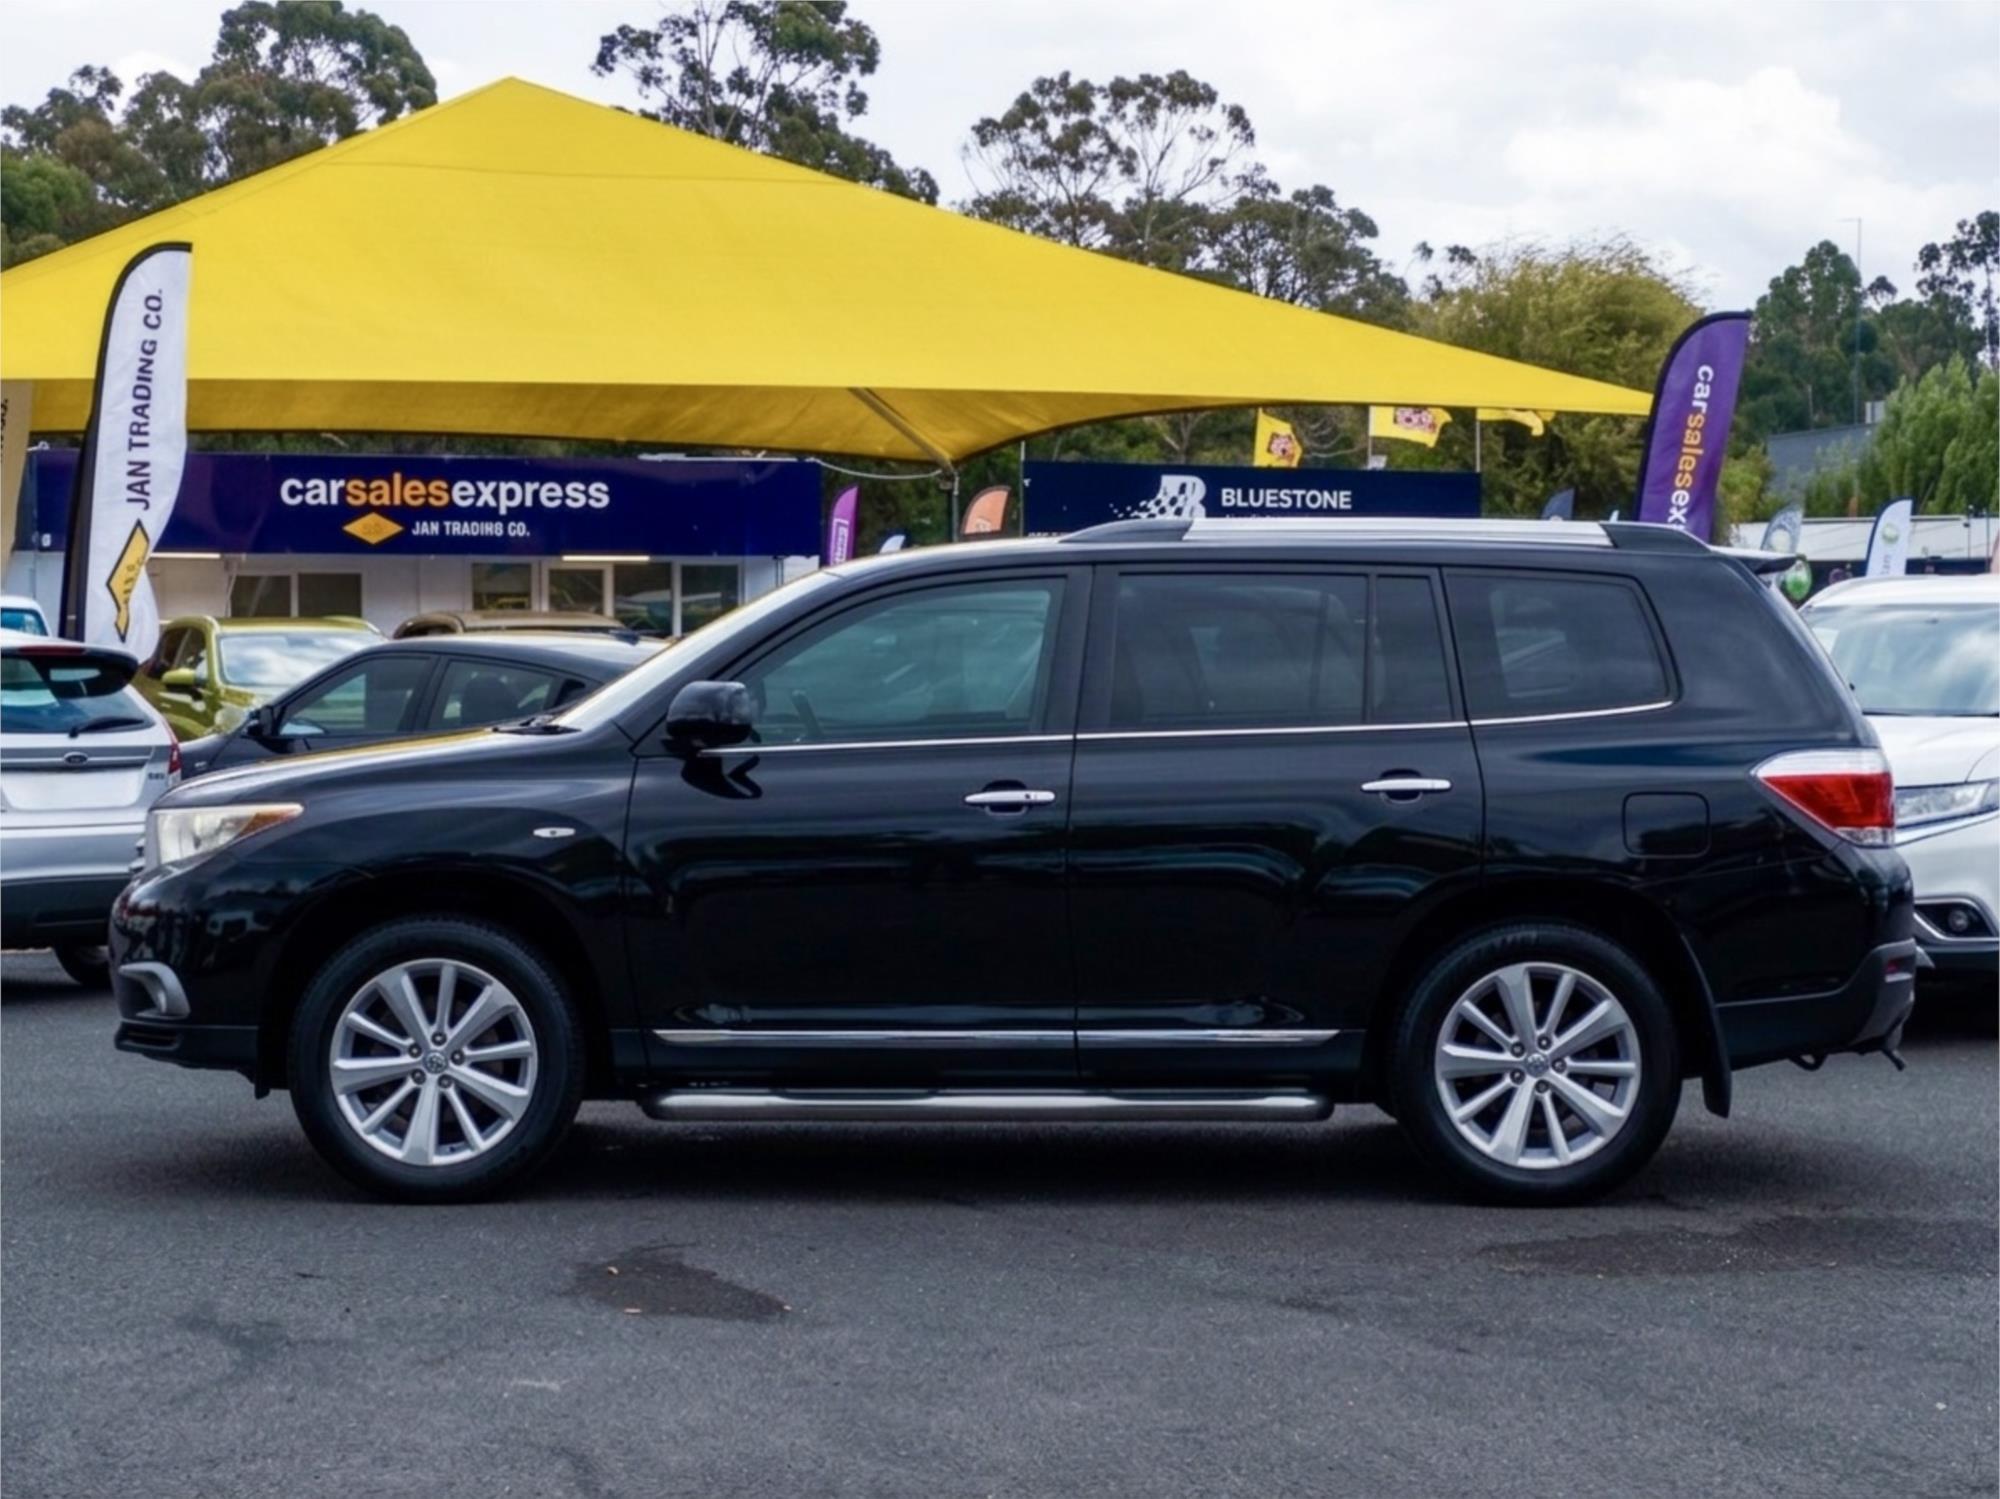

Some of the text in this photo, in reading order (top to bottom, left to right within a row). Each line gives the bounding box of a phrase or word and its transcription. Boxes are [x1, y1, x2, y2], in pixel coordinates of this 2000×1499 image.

[126, 288, 163, 511] JAN TRADING CO.
[280, 472, 610, 515] carsalesexpress
[1221, 488, 1352, 509] BLUESTONE
[412, 521, 439, 536] JAN
[507, 521, 530, 537] CO.
